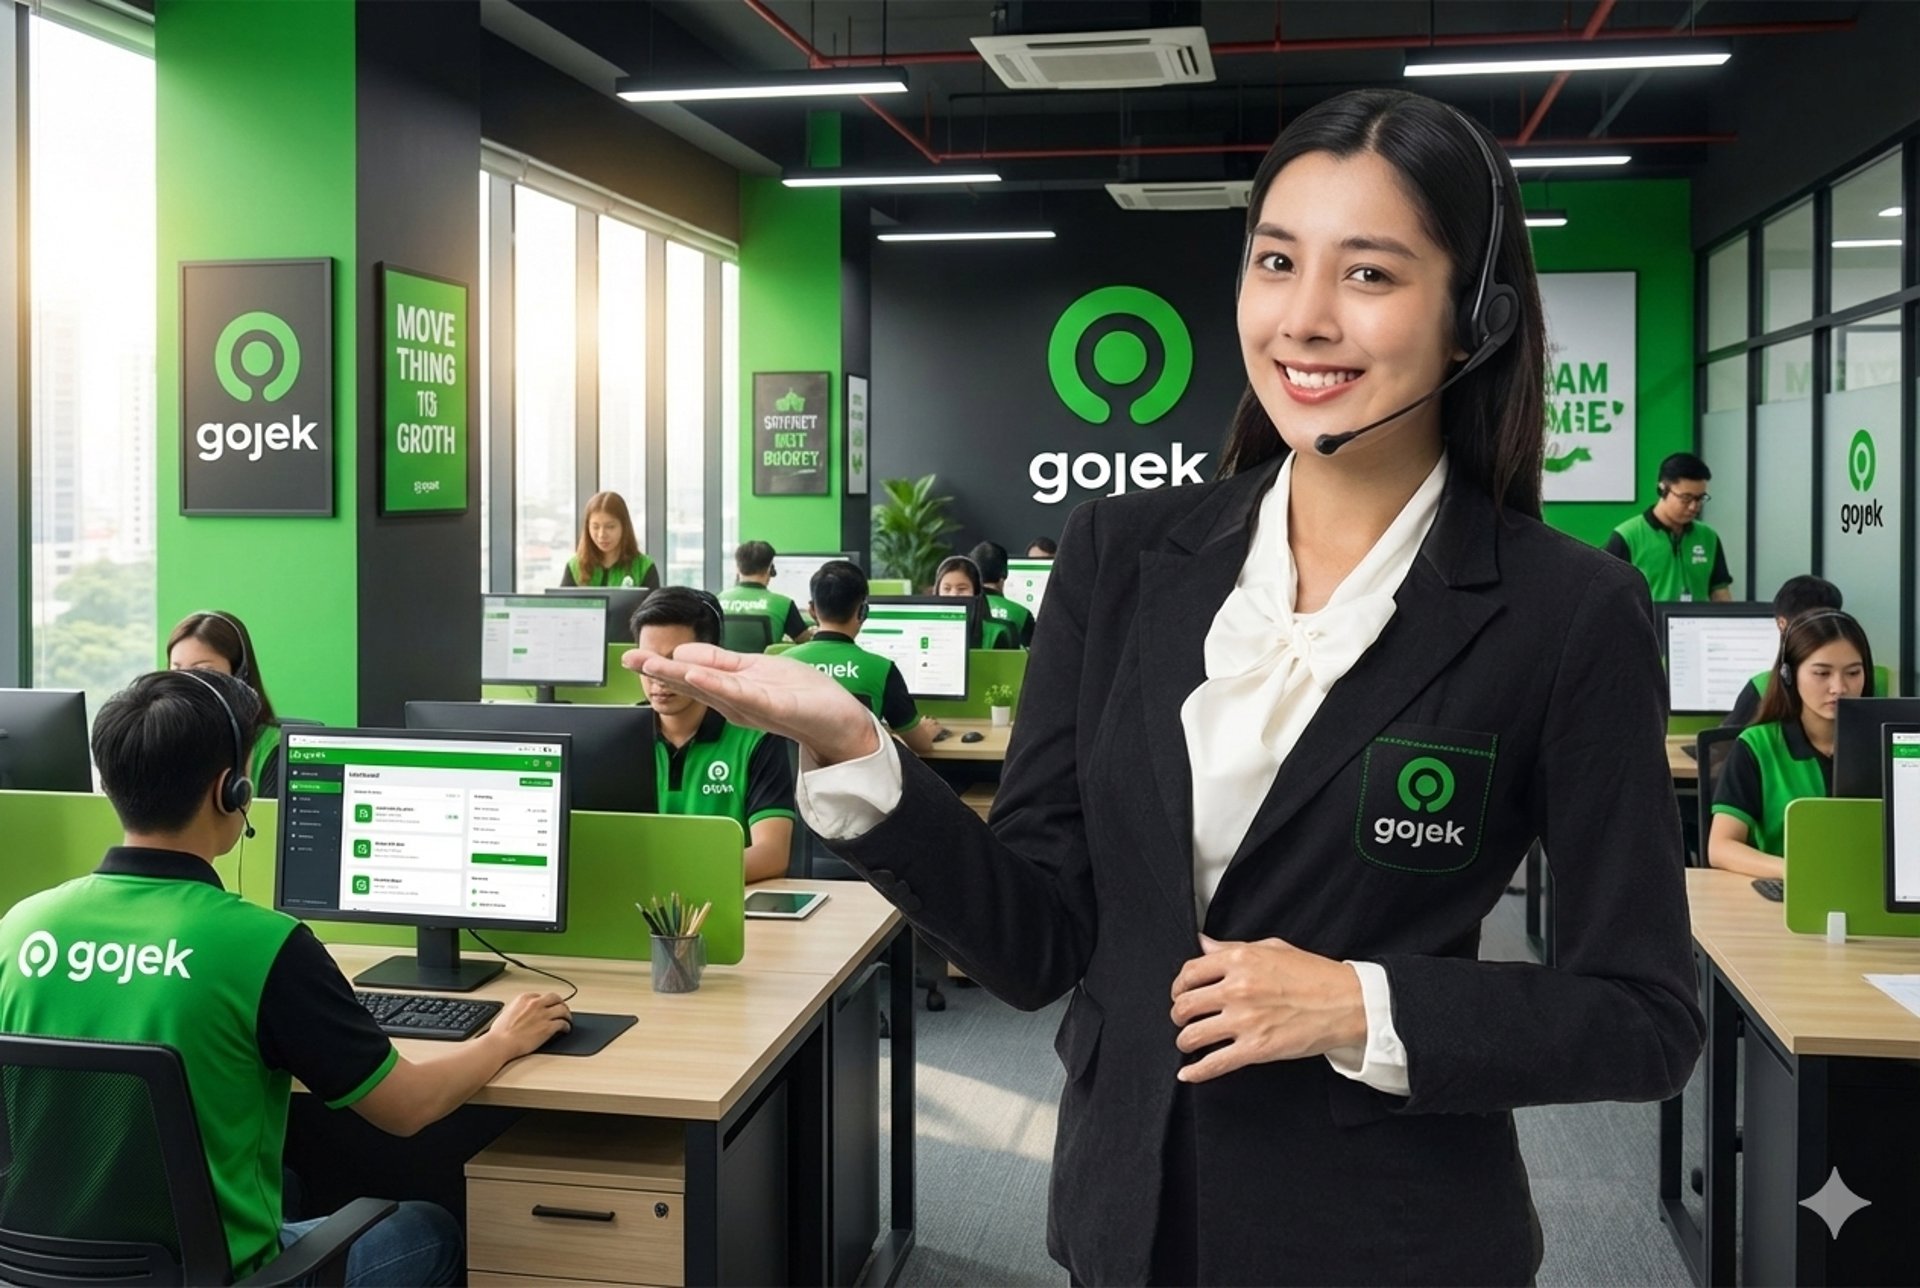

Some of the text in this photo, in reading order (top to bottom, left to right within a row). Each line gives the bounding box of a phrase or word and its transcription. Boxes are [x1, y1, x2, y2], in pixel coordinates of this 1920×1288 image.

[396, 303, 456, 348] MOVE
[396, 346, 456, 386] THING
[196, 414, 319, 462] gojek
[397, 422, 455, 455] GROTH
[1029, 442, 1209, 504] gojek
[809, 660, 860, 679] ojek
[1374, 817, 1466, 848] gojek
[67, 938, 194, 985] gojek
